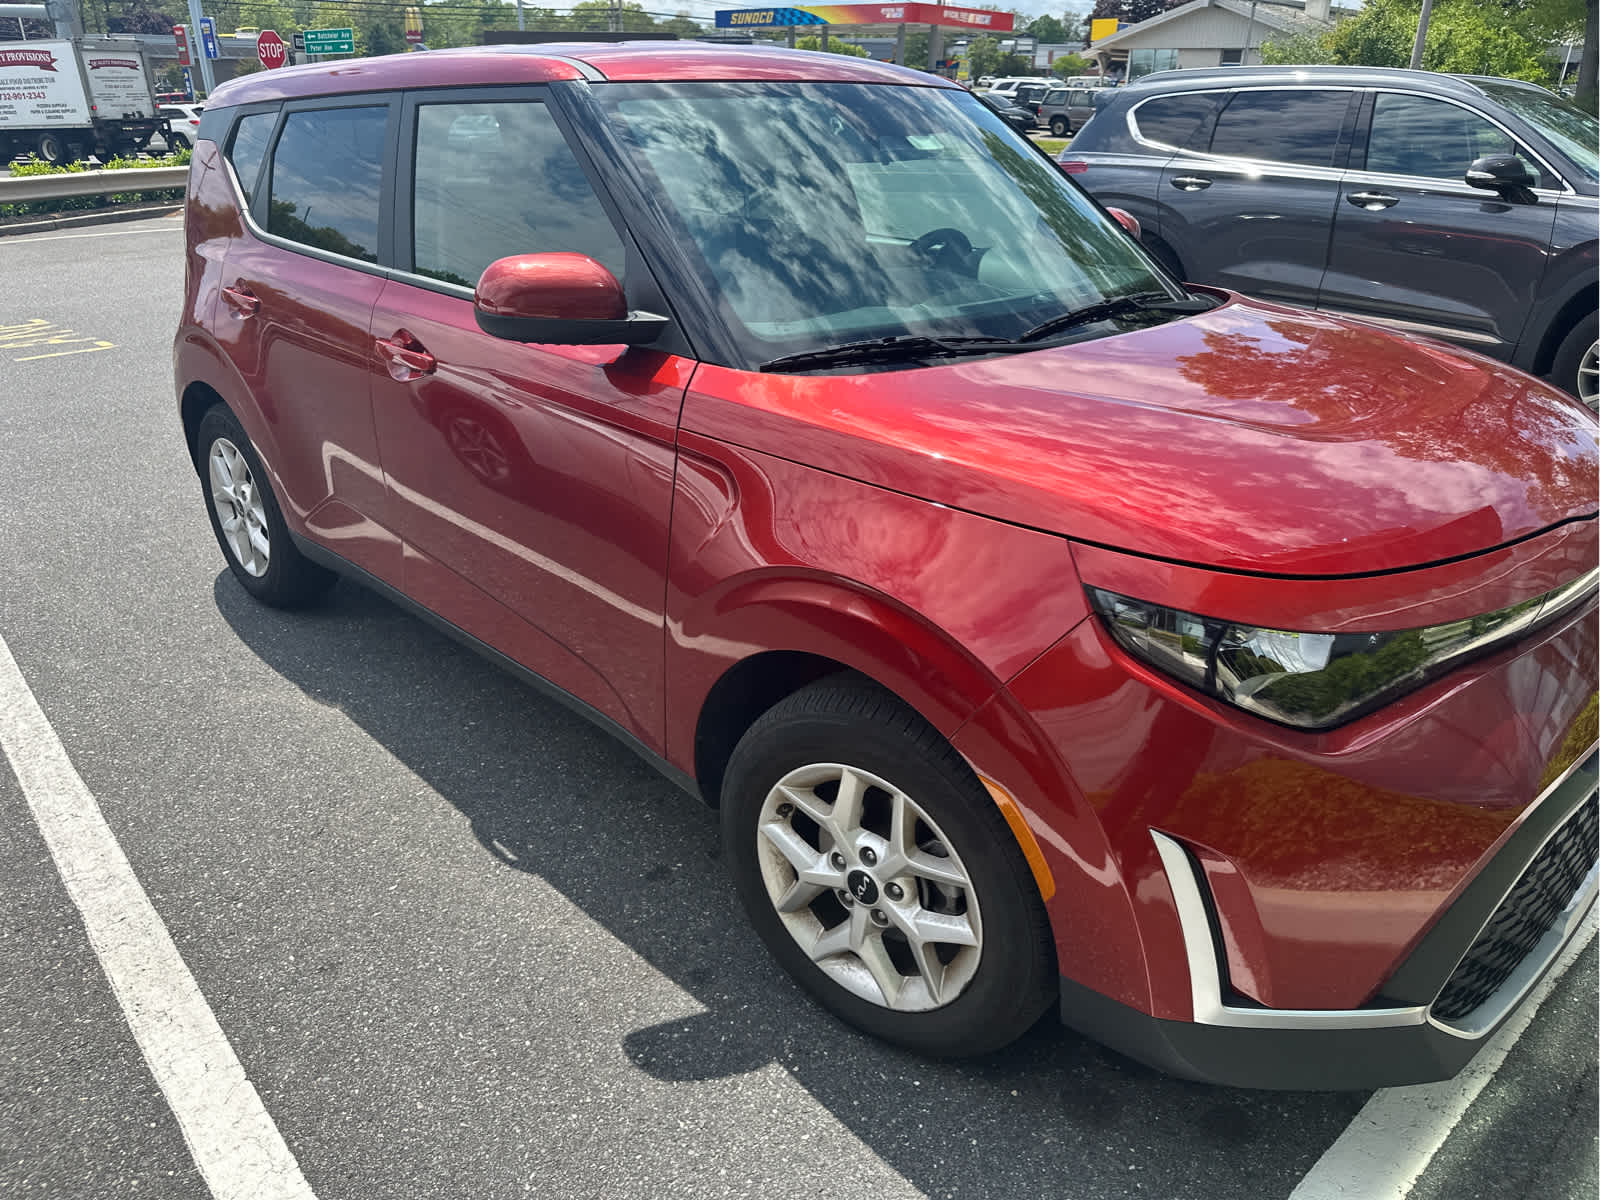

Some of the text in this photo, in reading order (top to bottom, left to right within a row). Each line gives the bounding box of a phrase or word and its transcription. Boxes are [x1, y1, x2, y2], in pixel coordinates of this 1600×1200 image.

[730, 11, 774, 24] SUNOCO
[6, 52, 51, 62] PROVISIONS
[259, 43, 282, 58] STOP
